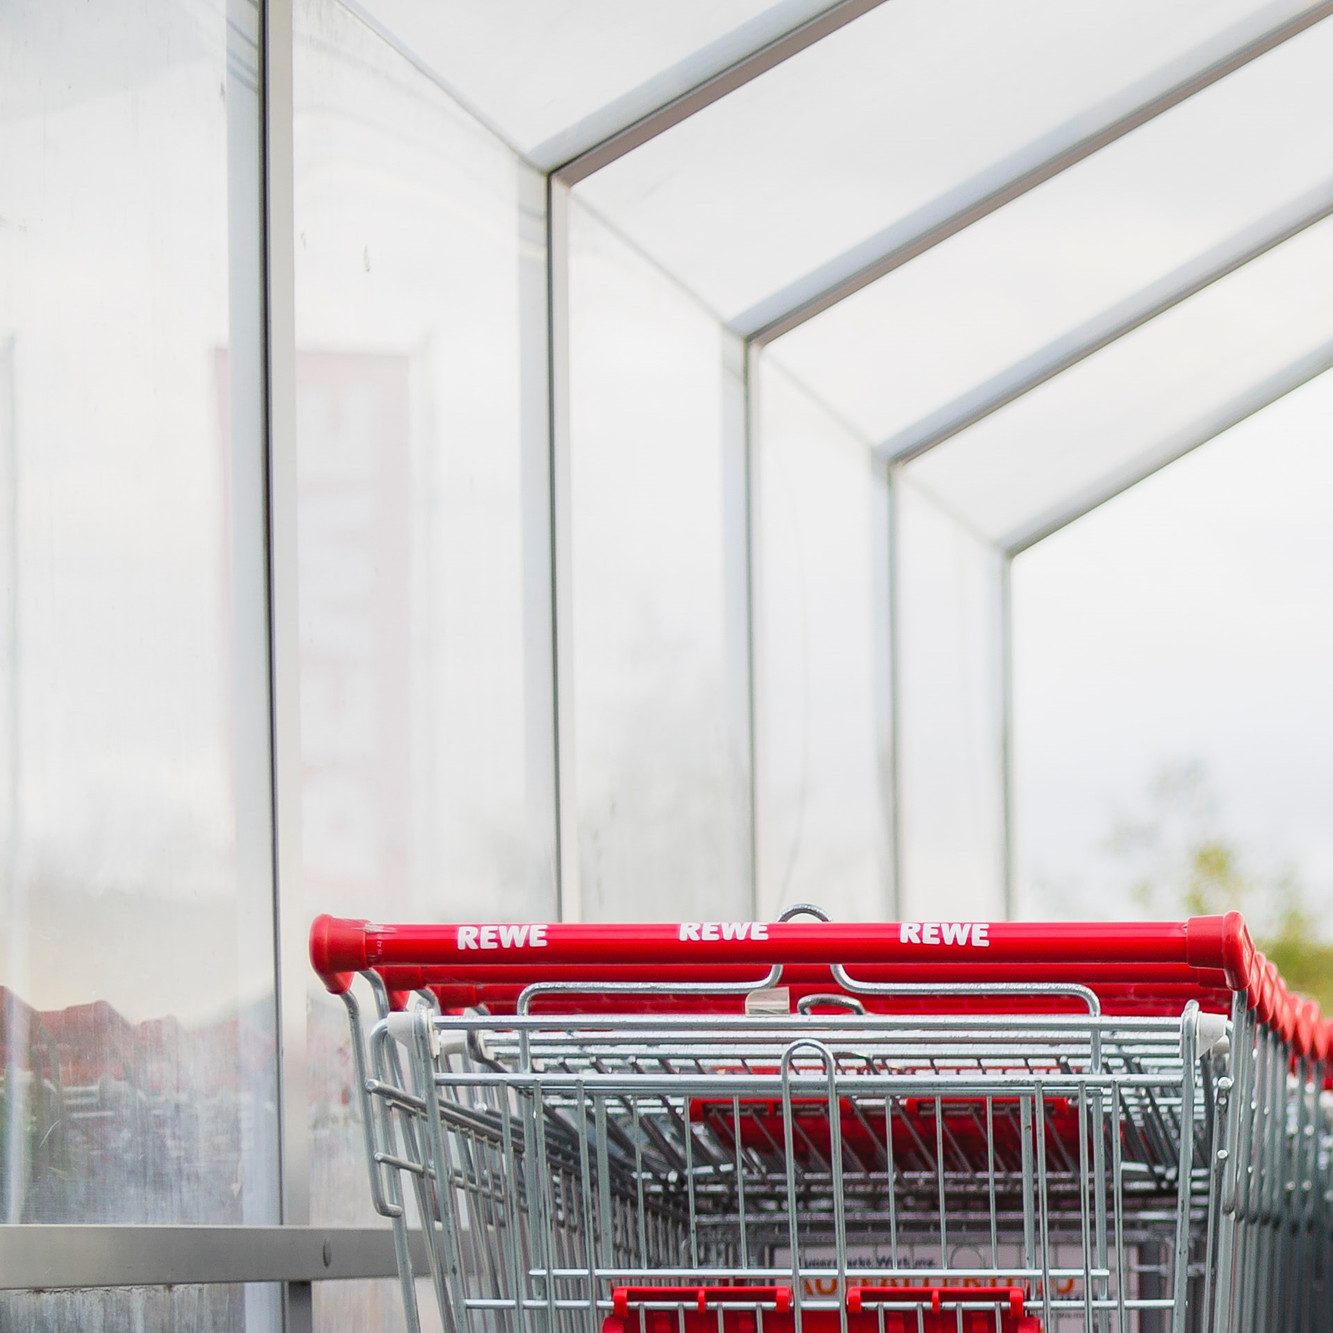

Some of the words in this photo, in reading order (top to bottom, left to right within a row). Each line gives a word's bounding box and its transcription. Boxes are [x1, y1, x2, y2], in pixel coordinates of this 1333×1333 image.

[458, 925, 547, 950] REWE
[679, 922, 769, 942] REWE
[901, 923, 990, 948] REWE
